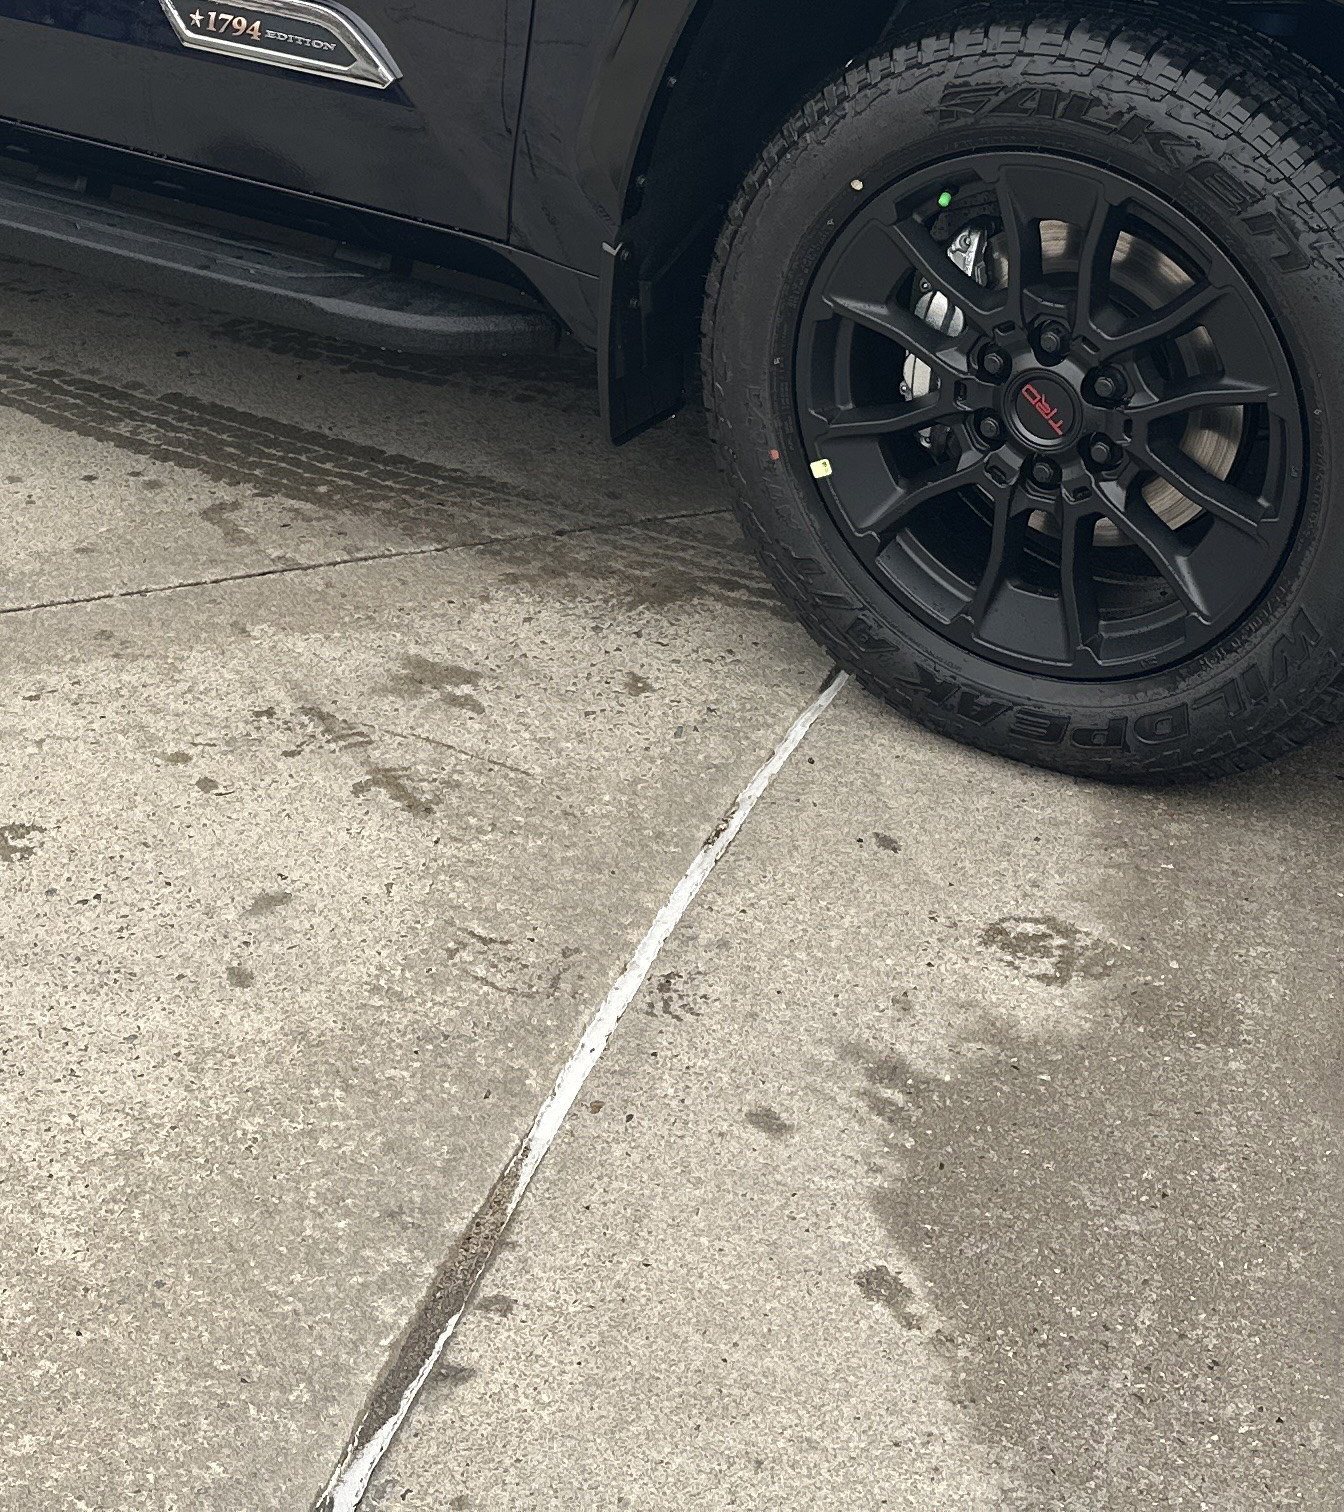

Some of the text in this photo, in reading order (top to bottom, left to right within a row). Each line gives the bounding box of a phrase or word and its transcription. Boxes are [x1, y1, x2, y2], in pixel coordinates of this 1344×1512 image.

[205, 11, 336, 51] 1794 EDITION
[1022, 383, 1064, 436] TRD
